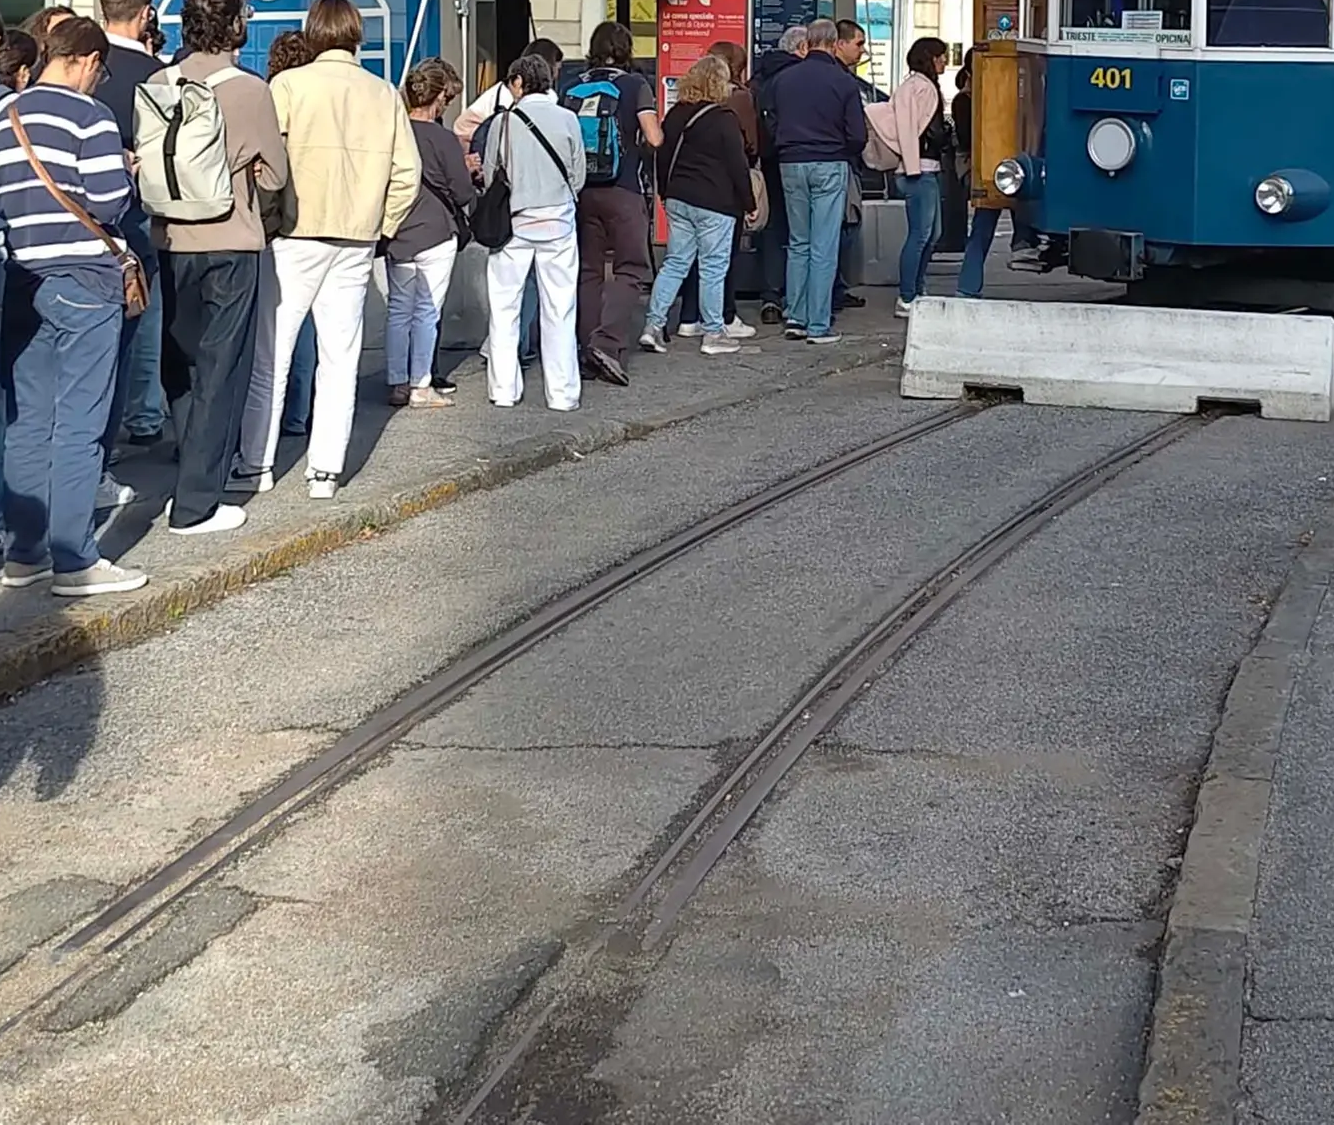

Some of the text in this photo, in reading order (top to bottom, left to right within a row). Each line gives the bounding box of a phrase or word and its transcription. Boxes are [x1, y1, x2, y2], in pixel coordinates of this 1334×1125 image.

[1065, 31, 1096, 42] TRIESTE
[1155, 33, 1190, 45] OPICINA
[1090, 67, 1133, 90] 401
